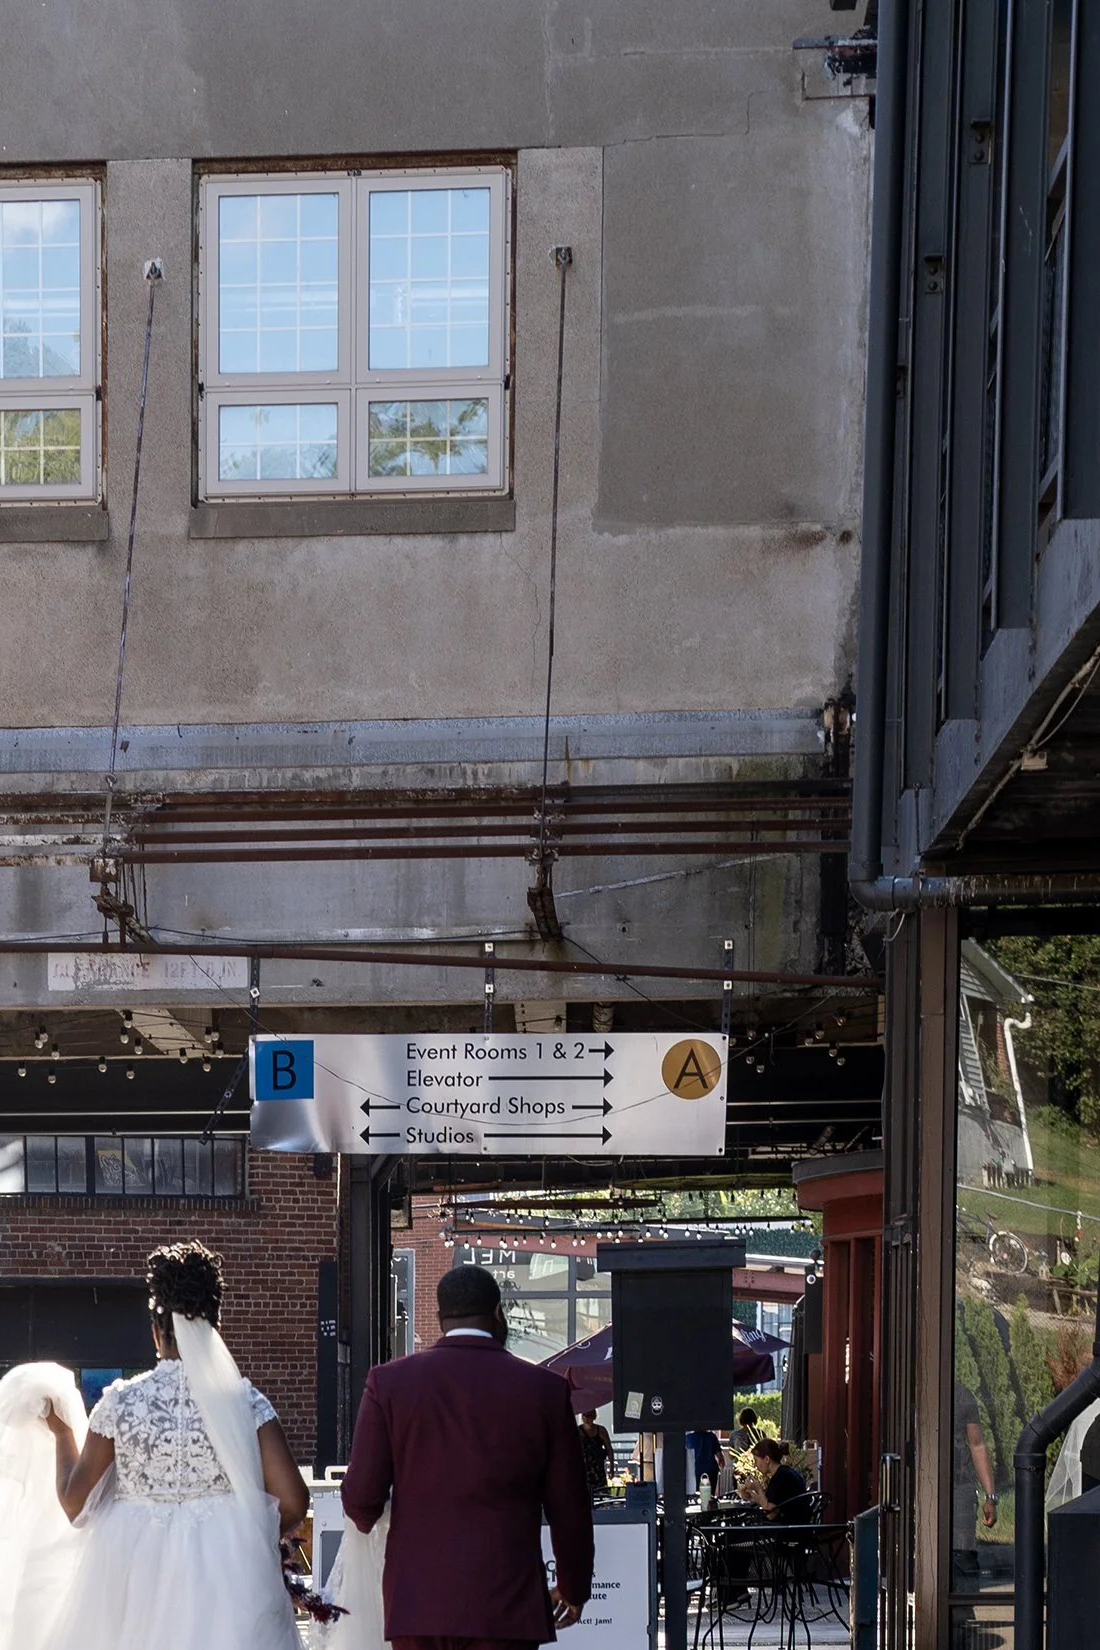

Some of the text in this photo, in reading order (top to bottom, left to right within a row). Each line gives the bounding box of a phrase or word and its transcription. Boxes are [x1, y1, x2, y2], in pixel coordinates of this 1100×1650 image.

[407, 1042, 585, 1060] Event Rooms 1 & 2
[272, 1050, 297, 1091] B
[673, 1047, 709, 1089] A
[407, 1069, 483, 1087] Elevator
[406, 1096, 565, 1119] Courtyard Shops
[406, 1126, 474, 1143] Studios
[595, 1617, 613, 1626] Jam!
